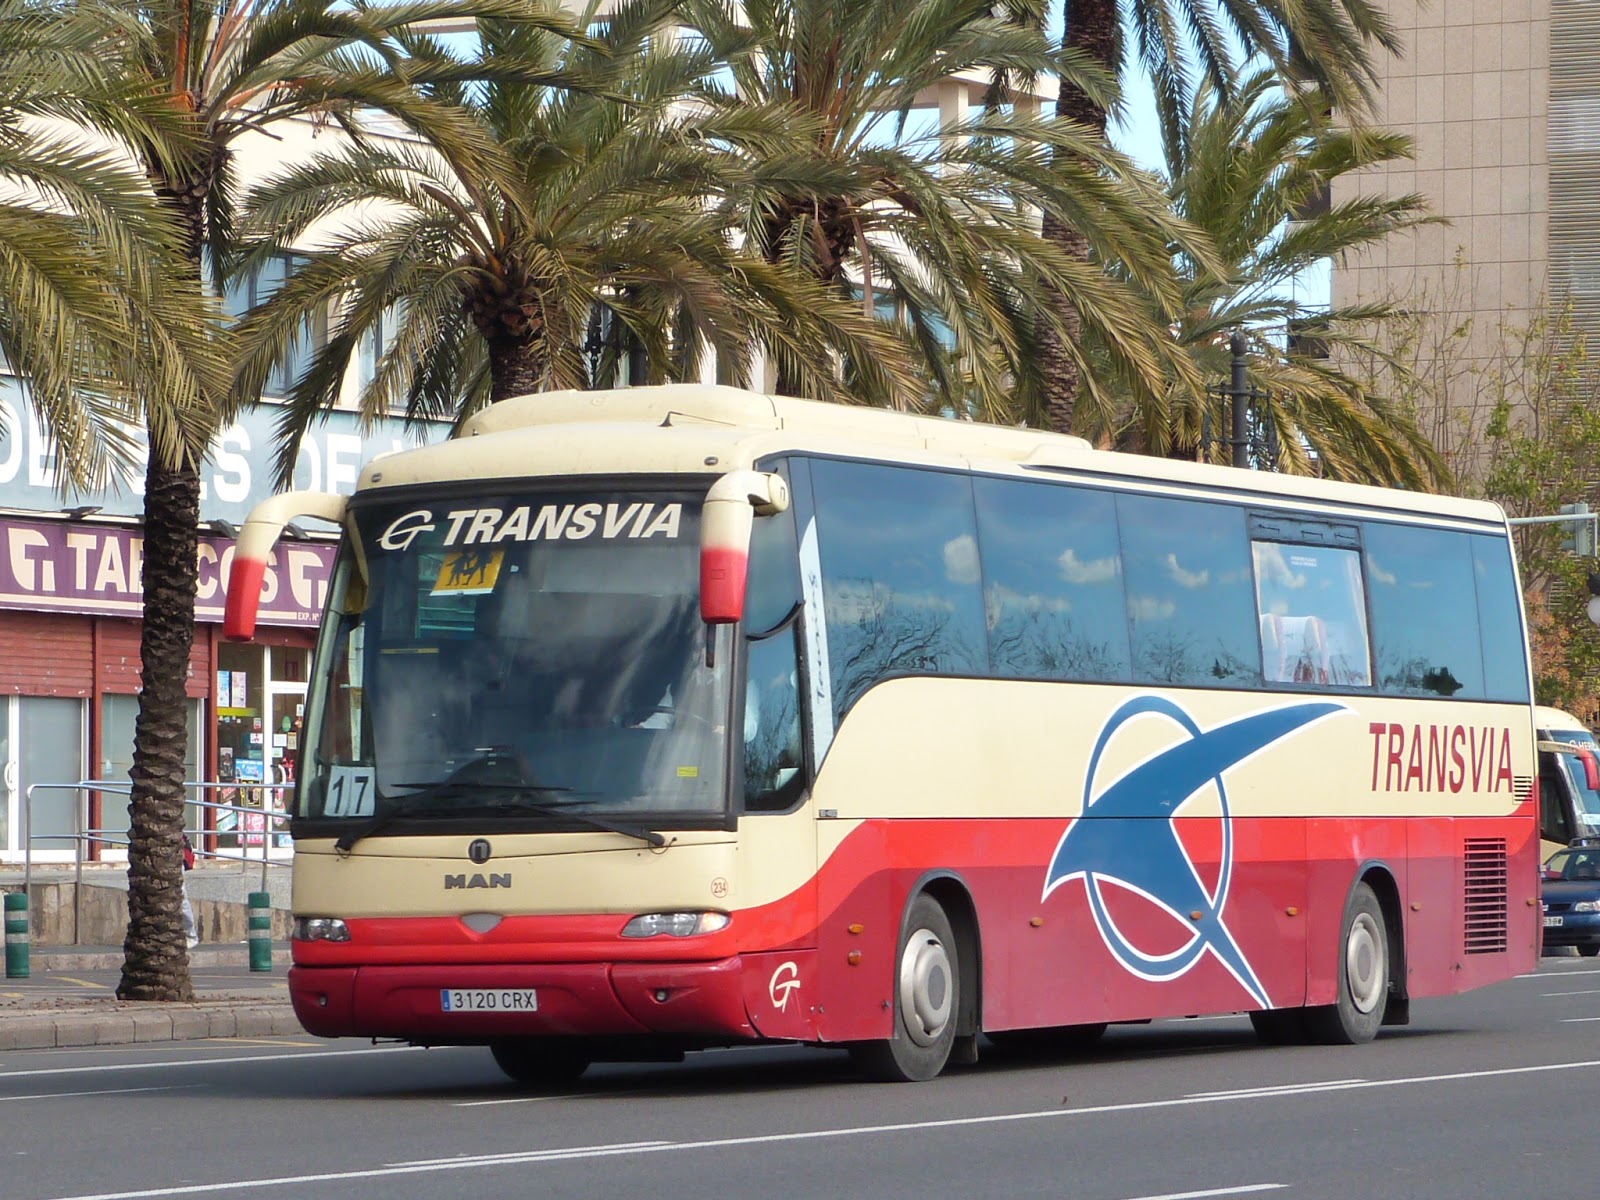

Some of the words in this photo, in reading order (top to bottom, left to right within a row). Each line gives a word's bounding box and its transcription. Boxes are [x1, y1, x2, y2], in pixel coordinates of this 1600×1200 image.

[443, 503, 683, 546] TRANSVIA
[67, 533, 279, 603] TABCS
[1369, 722, 1513, 793] TRANSVIA
[332, 775, 369, 814] 17
[444, 873, 512, 889] MAN
[714, 882, 727, 894] 234
[454, 992, 496, 1009] 3120
[502, 992, 534, 1009] CRX
